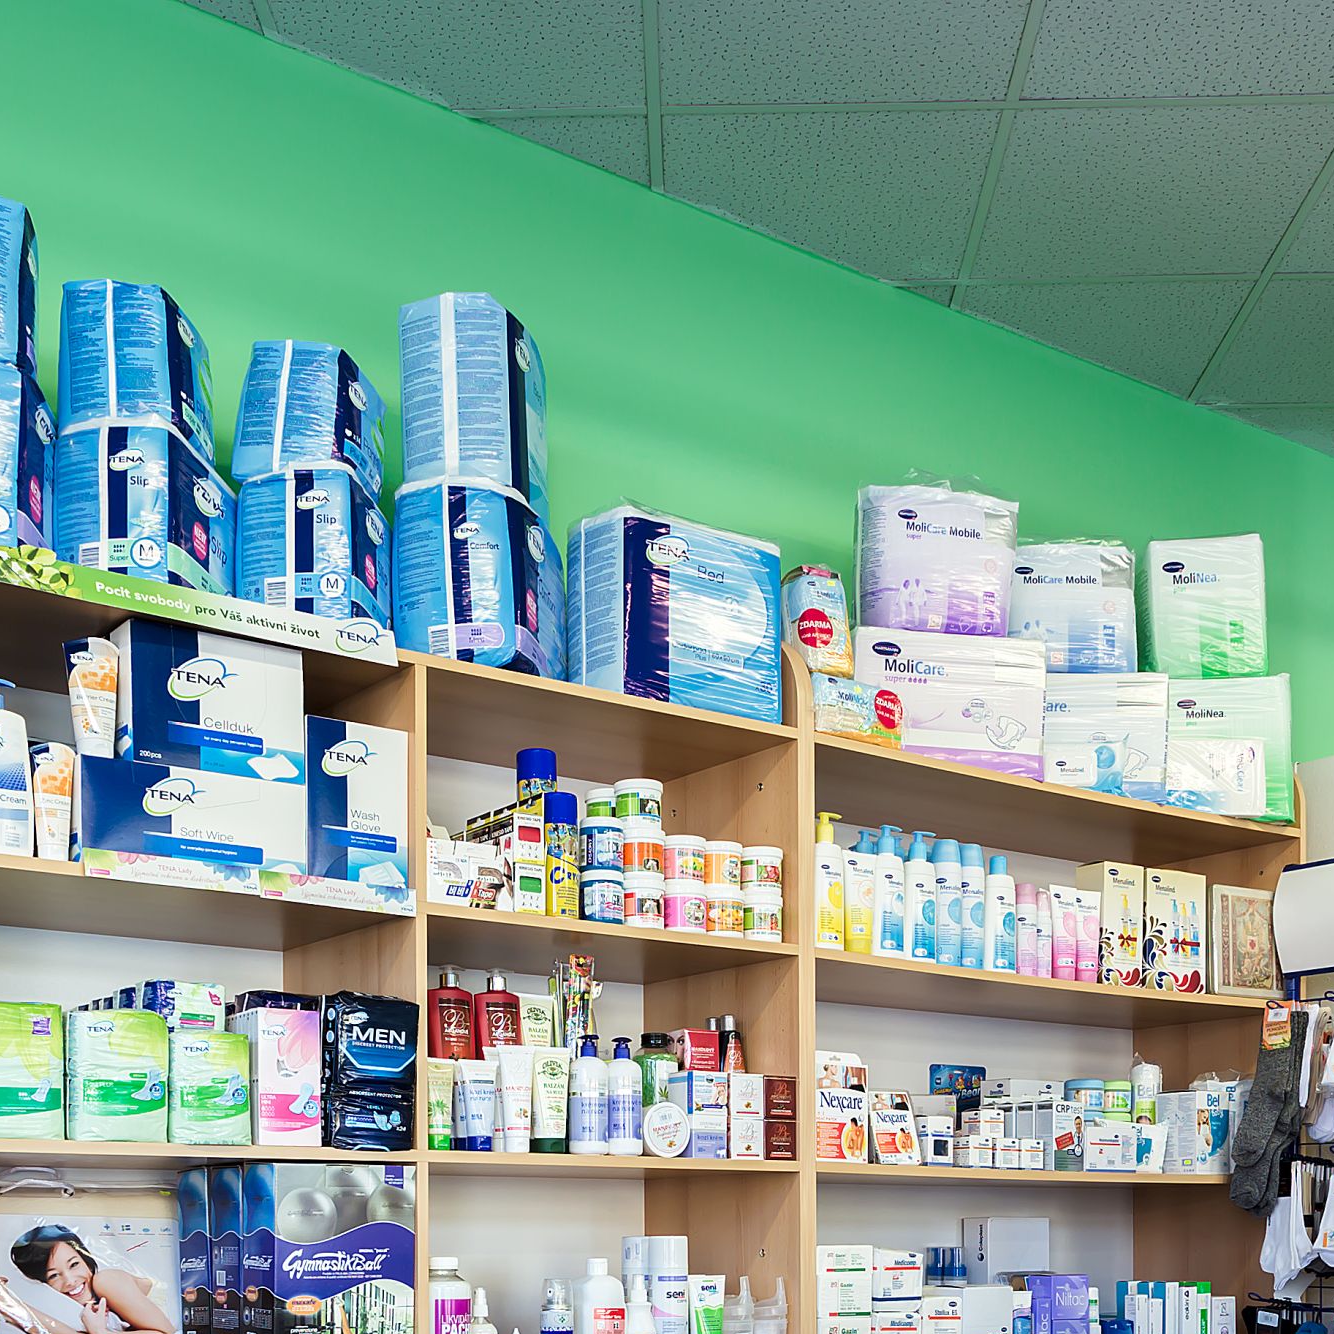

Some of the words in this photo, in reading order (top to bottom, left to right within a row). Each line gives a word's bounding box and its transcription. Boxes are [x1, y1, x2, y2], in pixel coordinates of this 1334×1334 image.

[109, 455, 145, 465] TENA
[130, 474, 150, 488] Slip
[298, 493, 330, 504] TENA
[316, 514, 337, 526] Slip
[454, 526, 479, 536] TENA
[906, 521, 947, 536] MoliCare
[469, 541, 500, 552] Comfort
[647, 538, 690, 562] TENA
[697, 565, 725, 584] Bed
[1023, 575, 1063, 584] MoliCare
[300, 585, 313, 593] Plus
[325, 578, 339, 590] M
[95, 581, 132, 600] Pocit
[134, 591, 191, 615] svobody
[194, 606, 217, 619] pro
[220, 606, 243, 623] Váš
[246, 613, 287, 632] aktivní
[290, 621, 320, 639] život
[336, 629, 380, 647] TENA
[799, 619, 832, 631] ZDARMA
[70, 654, 94, 663] TENA
[172, 667, 226, 689] TENA
[203, 716, 255, 735] Cellduk
[325, 749, 368, 765] TENA
[0, 794, 27, 805] Cream
[147, 789, 194, 804] TENA
[350, 808, 380, 821] Wash
[350, 820, 381, 833] Glove
[180, 826, 203, 840] Soft
[206, 830, 235, 843] Wipe
[262, 1029, 286, 1037] TENA
[352, 1027, 406, 1045] MEN
[183, 1045, 210, 1053] TENA
[542, 1060, 563, 1069] OLIVIA
[1137, 1084, 1155, 1097] Bel
[819, 1091, 863, 1113] Nexcare
[1207, 1094, 1220, 1107] Bel
[875, 1111, 907, 1124] Nexcare
[283, 1249, 388, 1279] GymnastikBall
[667, 1289, 686, 1299] seni
[1055, 1291, 1085, 1307] Niltac
